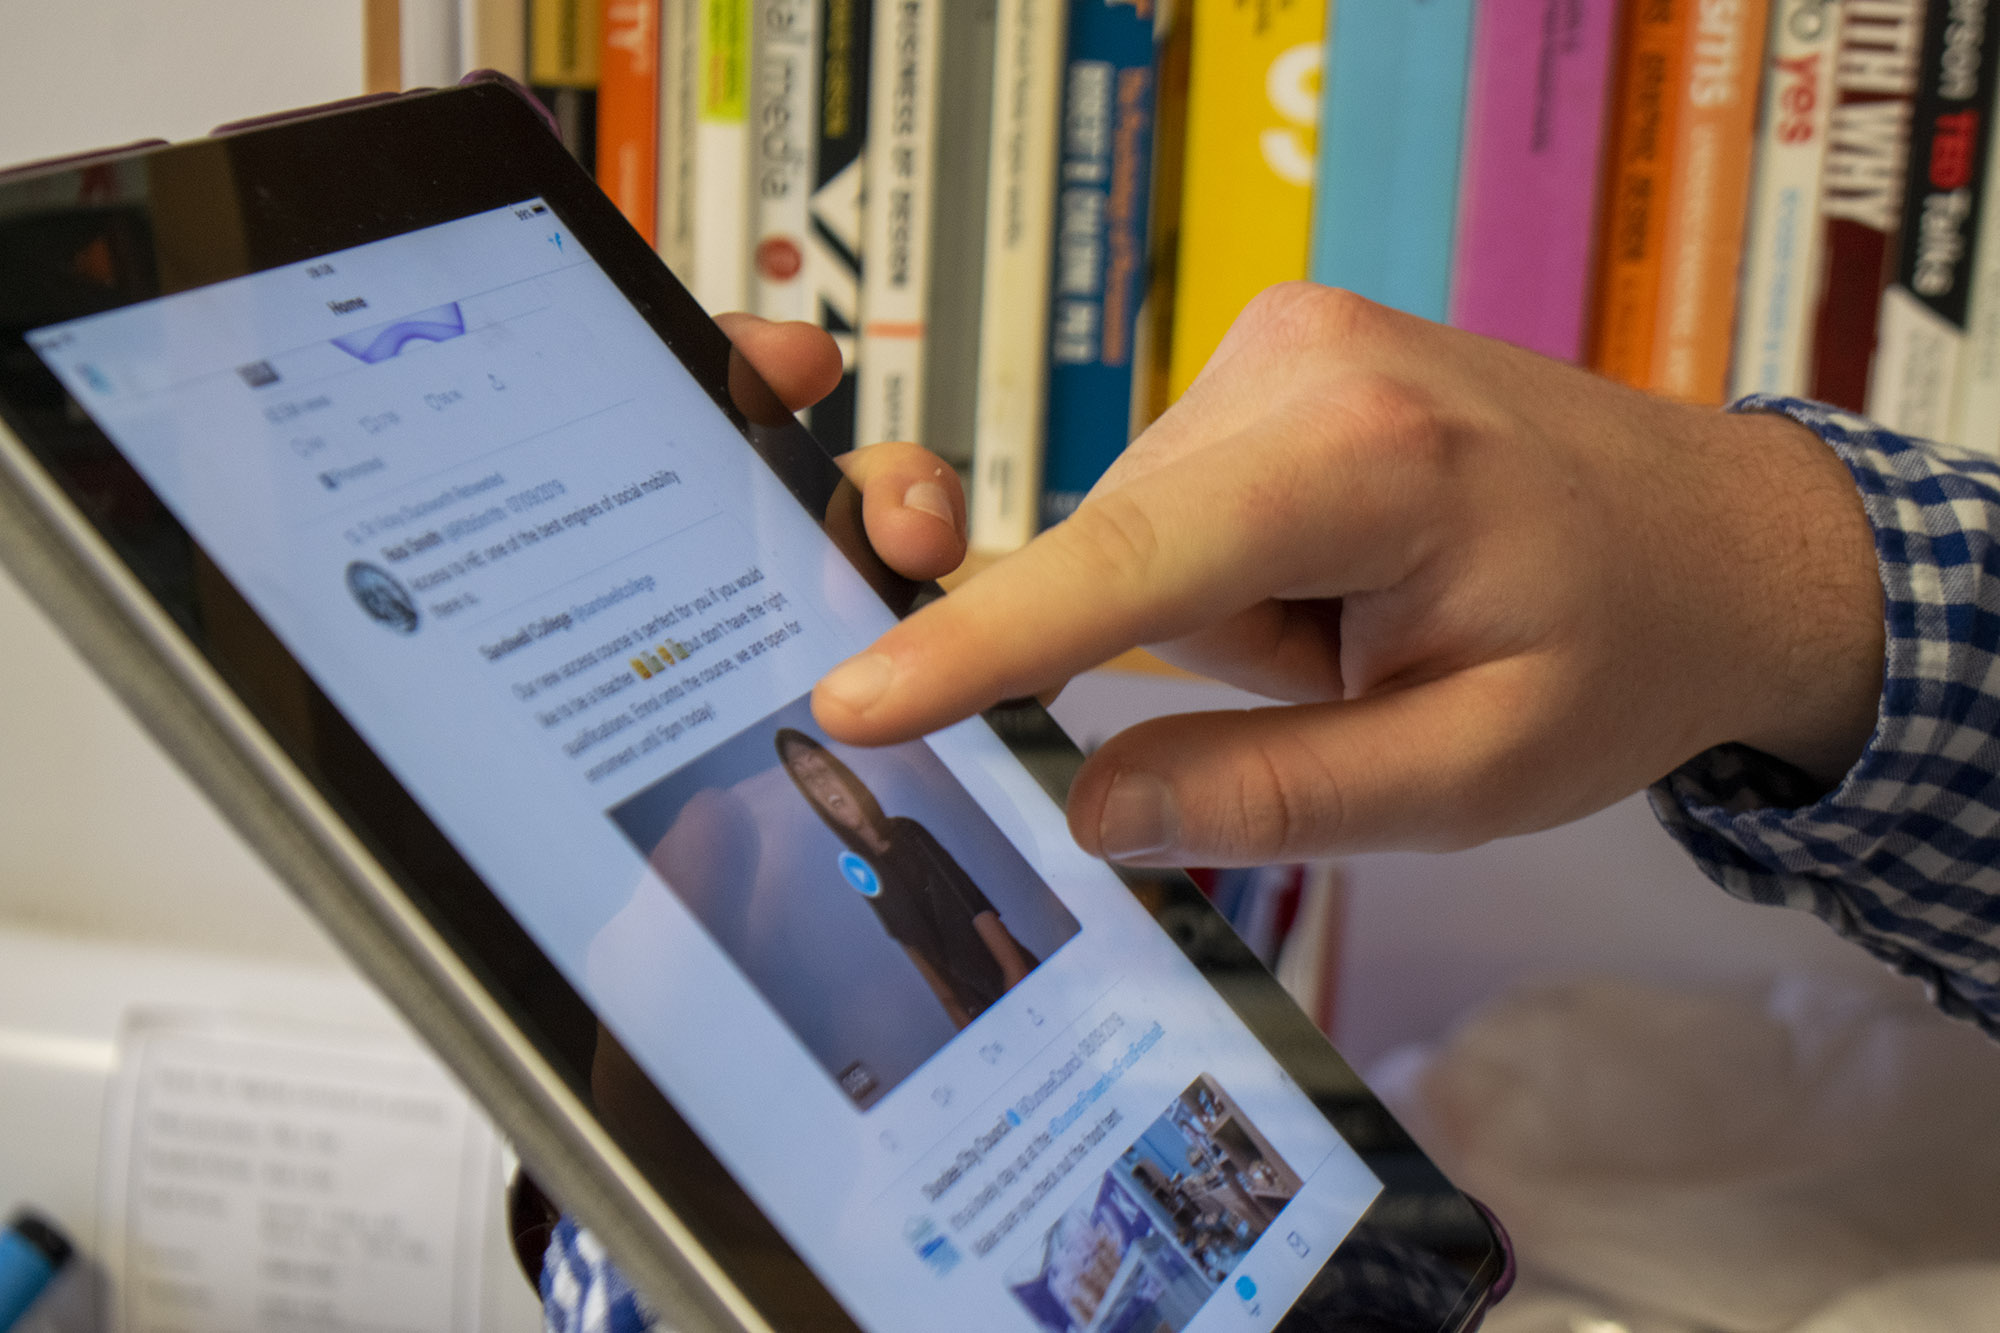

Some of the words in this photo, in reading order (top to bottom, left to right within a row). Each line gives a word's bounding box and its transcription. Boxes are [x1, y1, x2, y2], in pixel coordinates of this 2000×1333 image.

[893, 1, 921, 136] BUSINESS
[1775, 51, 1821, 146] yes
[762, 58, 807, 197] media
[891, 146, 915, 180] OF
[1820, 99, 1914, 231] WHY
[1928, 108, 1982, 191] TED
[888, 188, 913, 289] DESIGN
[1912, 186, 1974, 297] Talks
[329, 297, 367, 314] Home
[484, 543, 509, 561] one
[504, 535, 521, 552] of
[516, 530, 540, 545] the
[536, 518, 564, 538] best
[561, 503, 604, 528] engines
[600, 494, 614, 511] of
[611, 483, 643, 506] social
[639, 470, 681, 493] mobility
[527, 612, 573, 638] College
[559, 651, 599, 679] access
[594, 634, 634, 661] course
[640, 610, 679, 638] perfect
[673, 603, 693, 619] for
[690, 596, 713, 614] you
[717, 583, 738, 601] you
[735, 566, 764, 589] would
[592, 671, 635, 699] teacher
[679, 635, 704, 655] but
[700, 622, 728, 644] don't
[724, 612, 751, 630] have
[745, 604, 765, 619] the
[762, 591, 788, 612] right
[680, 675, 702, 691] the
[735, 649, 751, 663] we
[748, 640, 767, 656] are
[763, 628, 789, 648] open
[783, 620, 802, 635] for
[655, 721, 685, 742] 5pm
[1031, 1170, 1061, 1201] check
[1056, 1154, 1075, 1177] out
[1068, 1142, 1088, 1162] the
[1082, 1123, 1107, 1147] food
